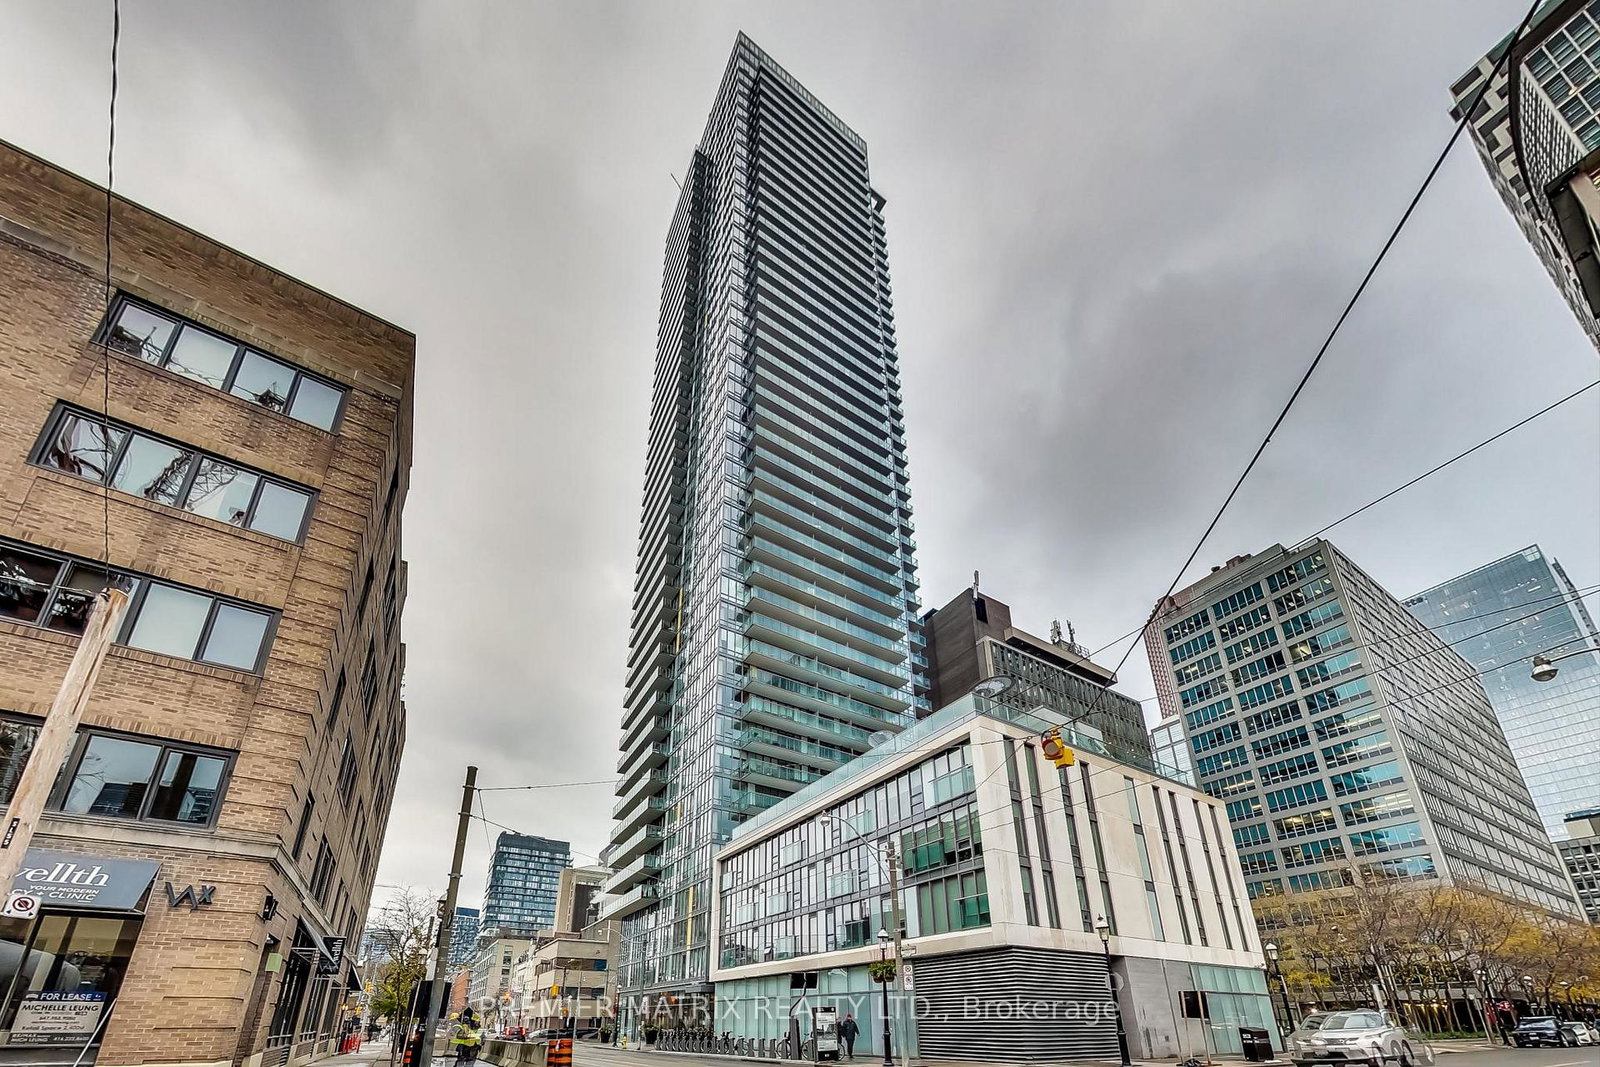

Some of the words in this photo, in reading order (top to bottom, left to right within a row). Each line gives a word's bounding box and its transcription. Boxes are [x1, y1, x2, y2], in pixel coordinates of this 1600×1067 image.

[58, 887, 100, 895] MODERN
[52, 891, 97, 901] CLINIC
[40, 992, 60, 1001] FOR
[61, 993, 93, 1001] LEASE
[21, 1004, 68, 1012] MICHELLE
[69, 1004, 99, 1012] LEUNG
